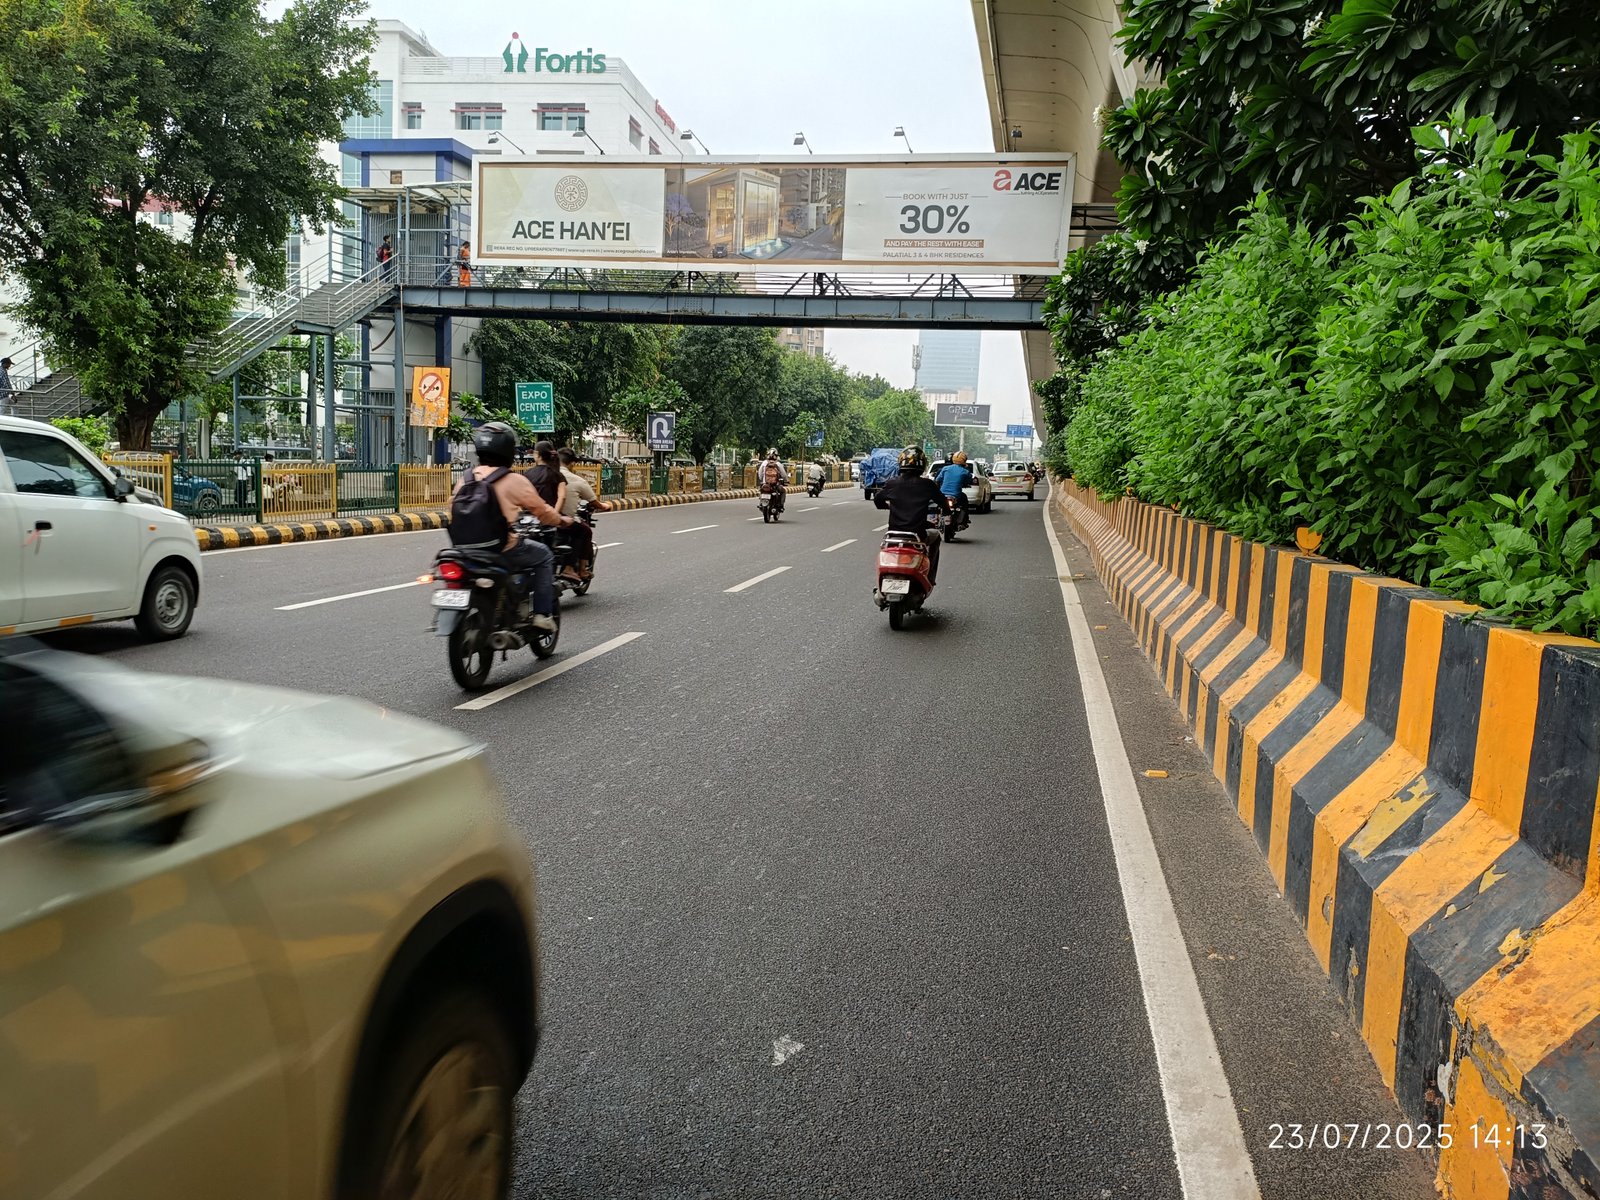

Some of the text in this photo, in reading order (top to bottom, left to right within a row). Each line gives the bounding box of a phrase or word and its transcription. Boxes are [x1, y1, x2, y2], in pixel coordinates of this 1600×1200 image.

[535, 47, 607, 74] Fortis
[1013, 172, 1062, 191] ACE
[899, 204, 970, 234] 30%
[512, 220, 554, 240] ACE
[521, 391, 548, 399] EXPO
[520, 402, 551, 412] CENTRE
[948, 405, 980, 415] GREAT
